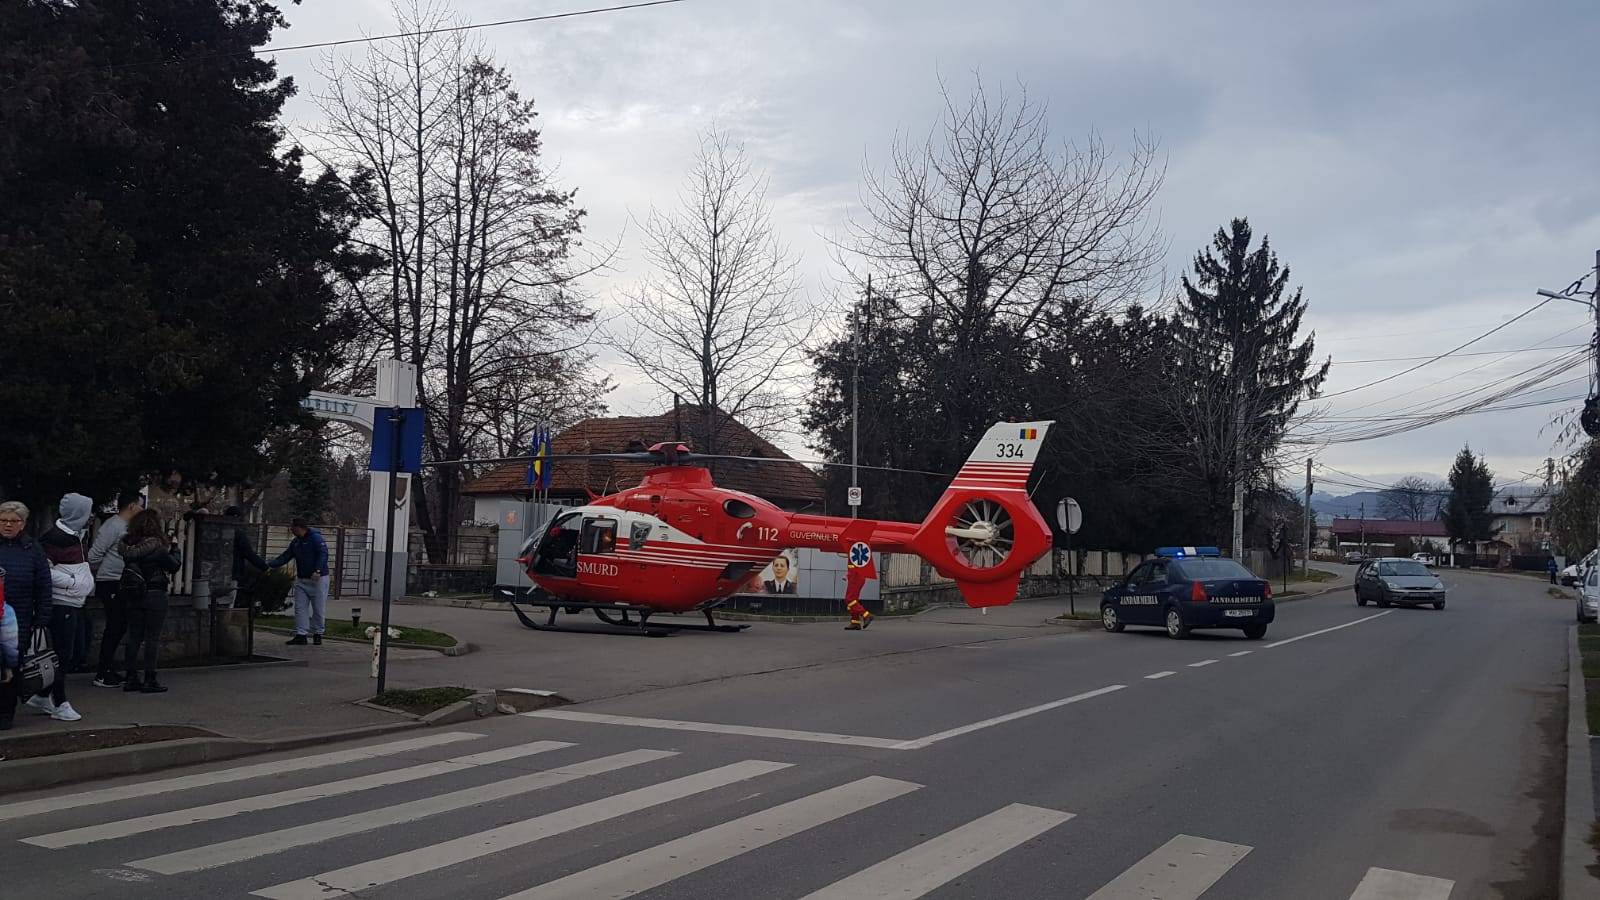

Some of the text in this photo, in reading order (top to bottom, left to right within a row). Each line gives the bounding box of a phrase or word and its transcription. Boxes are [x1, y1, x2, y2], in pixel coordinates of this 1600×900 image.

[996, 443, 1024, 459] 334
[758, 526, 779, 542] 112
[789, 530, 832, 542] GUVERNUL
[576, 561, 619, 577] SMURD
